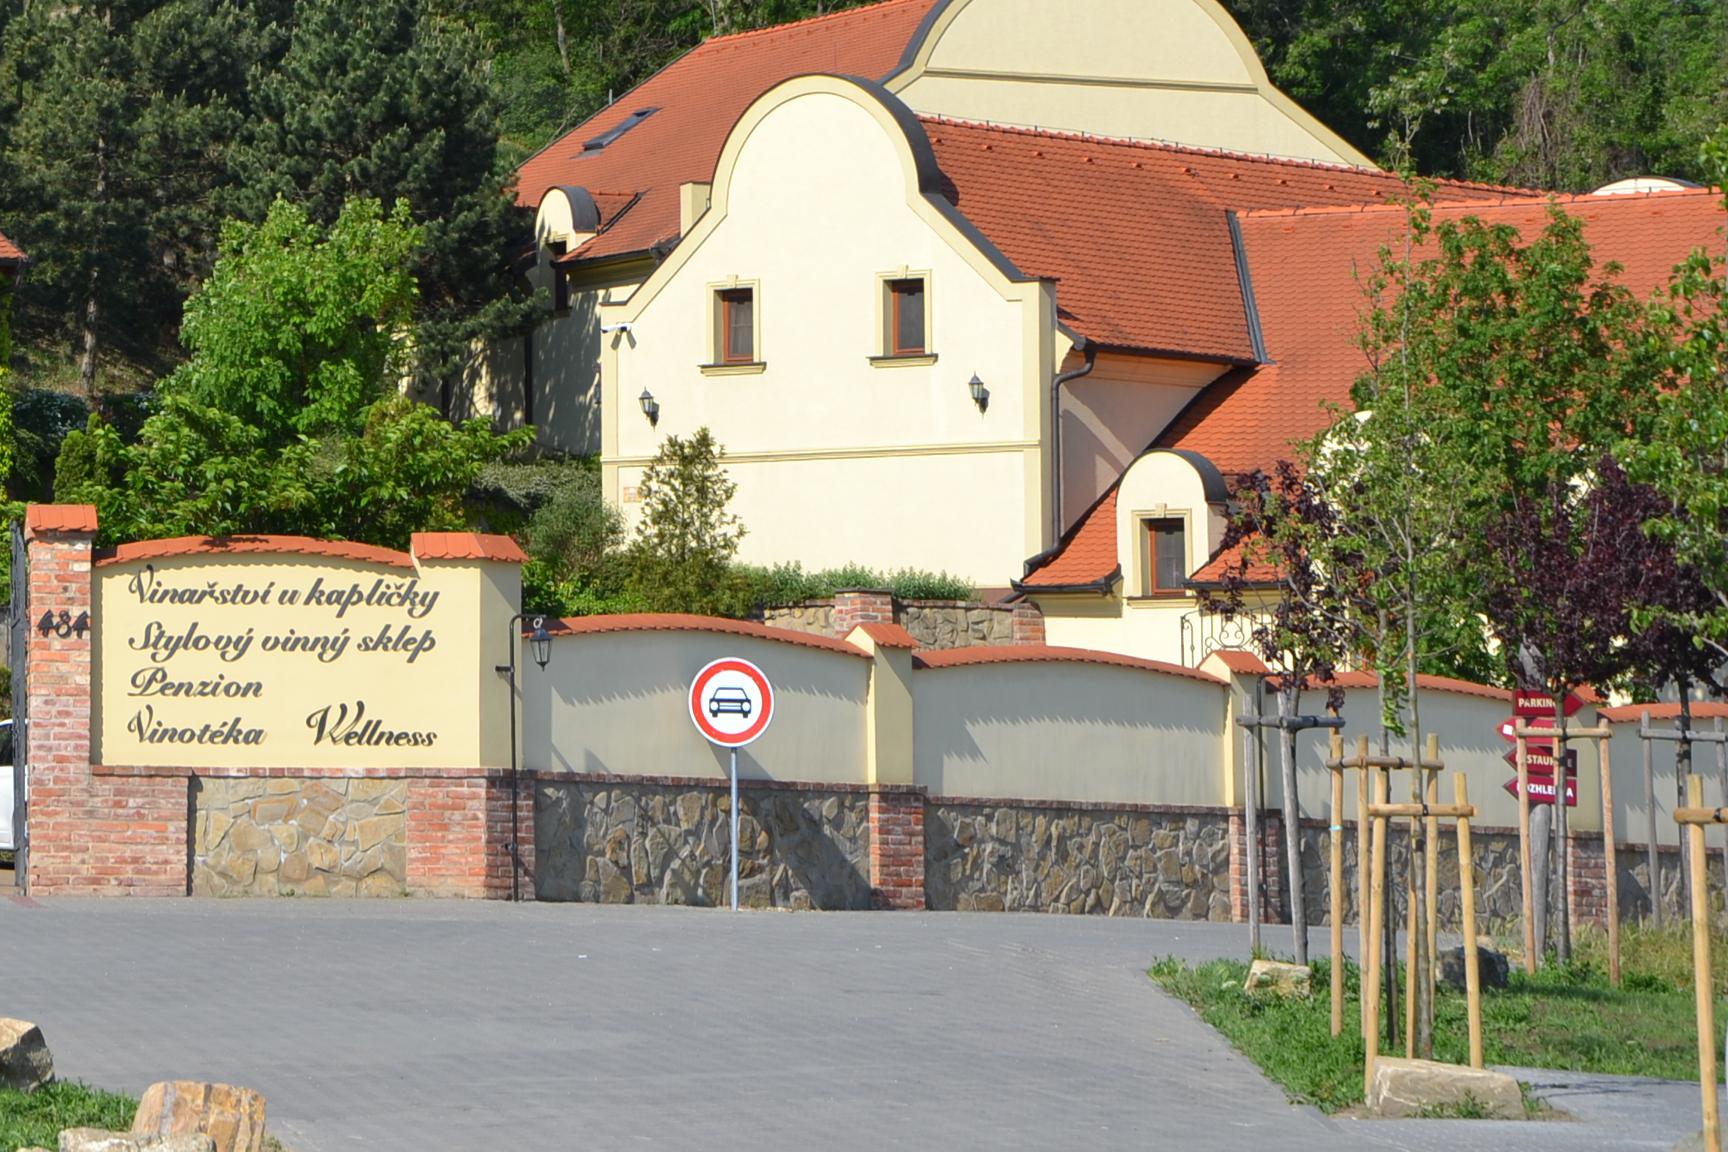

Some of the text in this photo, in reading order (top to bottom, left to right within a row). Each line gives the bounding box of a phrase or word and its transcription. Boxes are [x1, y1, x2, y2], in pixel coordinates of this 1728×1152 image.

[127, 563, 441, 619] Vinařství u kapličky
[128, 620, 437, 664] Stylový vinný sklep
[127, 666, 264, 698] Penzion
[127, 700, 438, 747] Vinotéka Wellness
